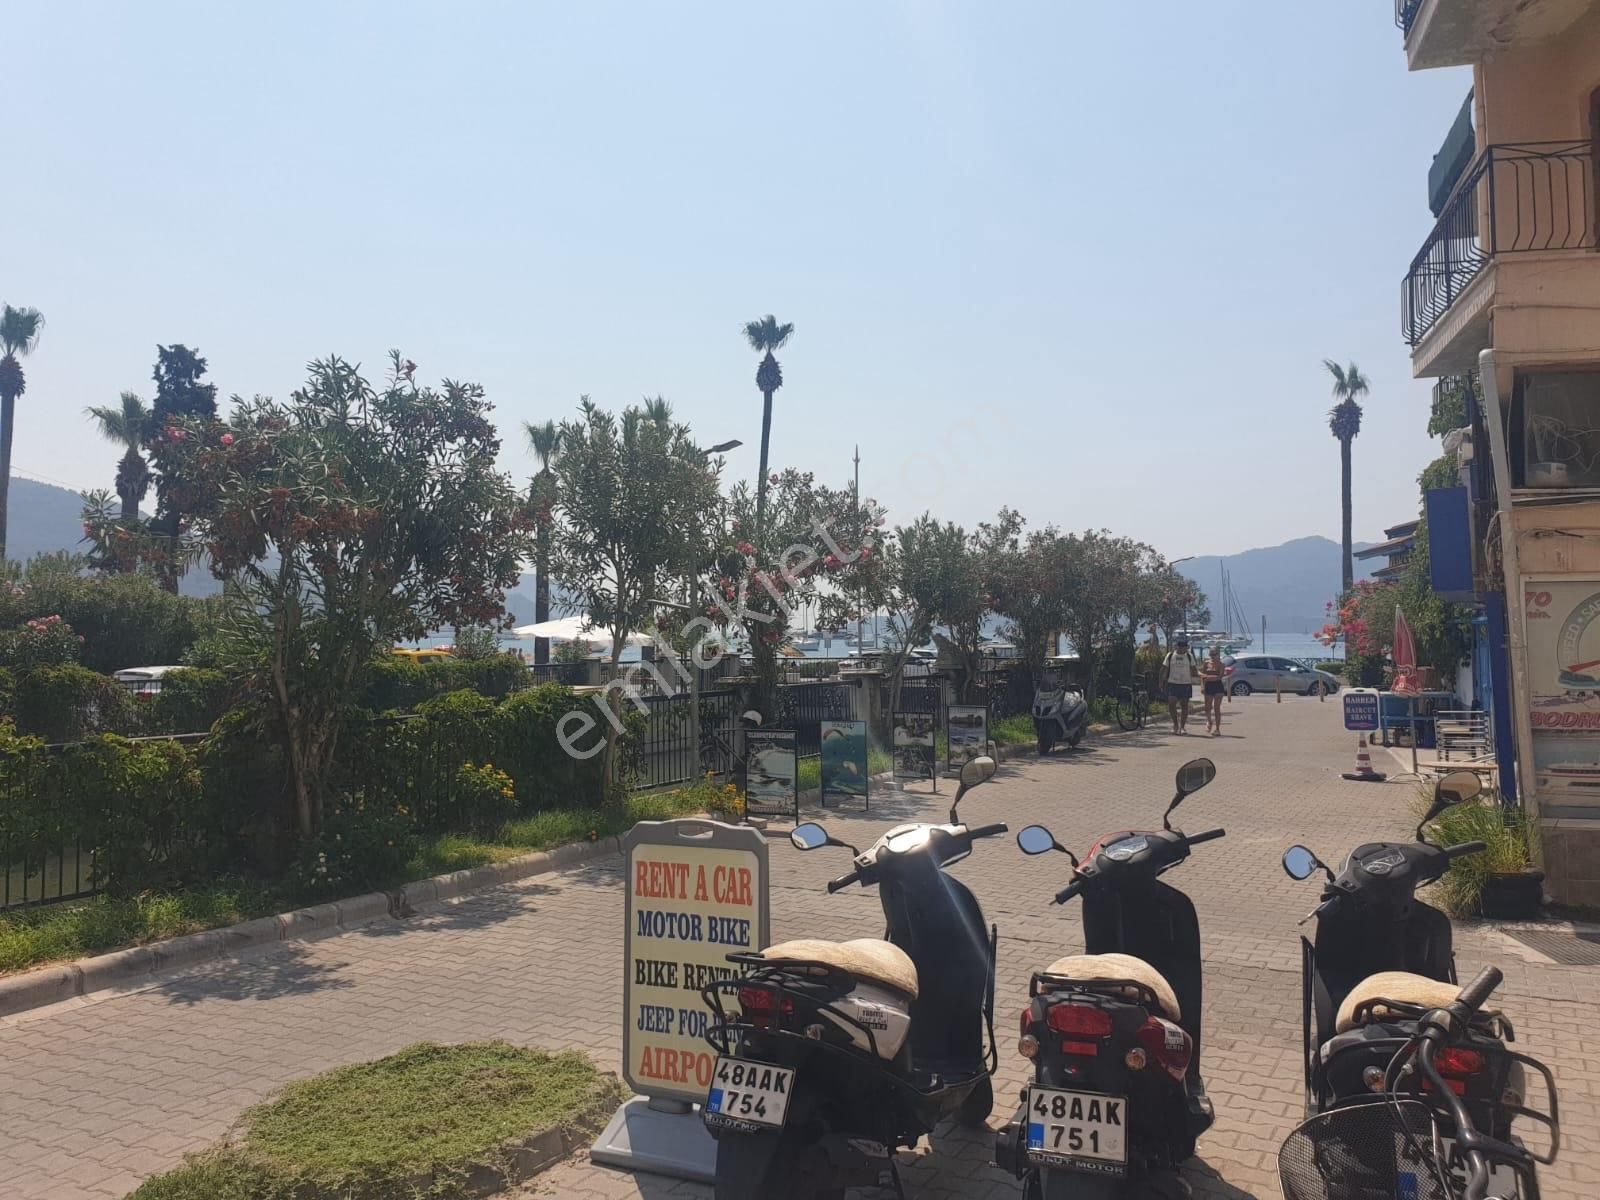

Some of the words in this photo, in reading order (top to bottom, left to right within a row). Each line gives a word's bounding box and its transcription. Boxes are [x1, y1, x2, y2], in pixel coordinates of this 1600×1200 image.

[1346, 706, 1377, 714] HAIRCUT
[1350, 713, 1373, 721] SHAVE
[635, 860, 690, 900] RENT
[694, 864, 709, 902] A
[713, 865, 753, 906] CAR
[637, 909, 703, 942] MOTOR
[707, 915, 751, 947] BIKE
[635, 958, 678, 989] BIKE
[637, 1004, 675, 1034] JEEP
[678, 1008, 708, 1039] FOR
[639, 1046, 719, 1088] AIRPO
[717, 1062, 788, 1094] 48AAK
[727, 1090, 767, 1118] 754
[1033, 1093, 1122, 1125] 48AAK
[1031, 1139, 1041, 1147] TR
[1050, 1125, 1099, 1154] 751
[1075, 1160, 1124, 1174] MOTOR
